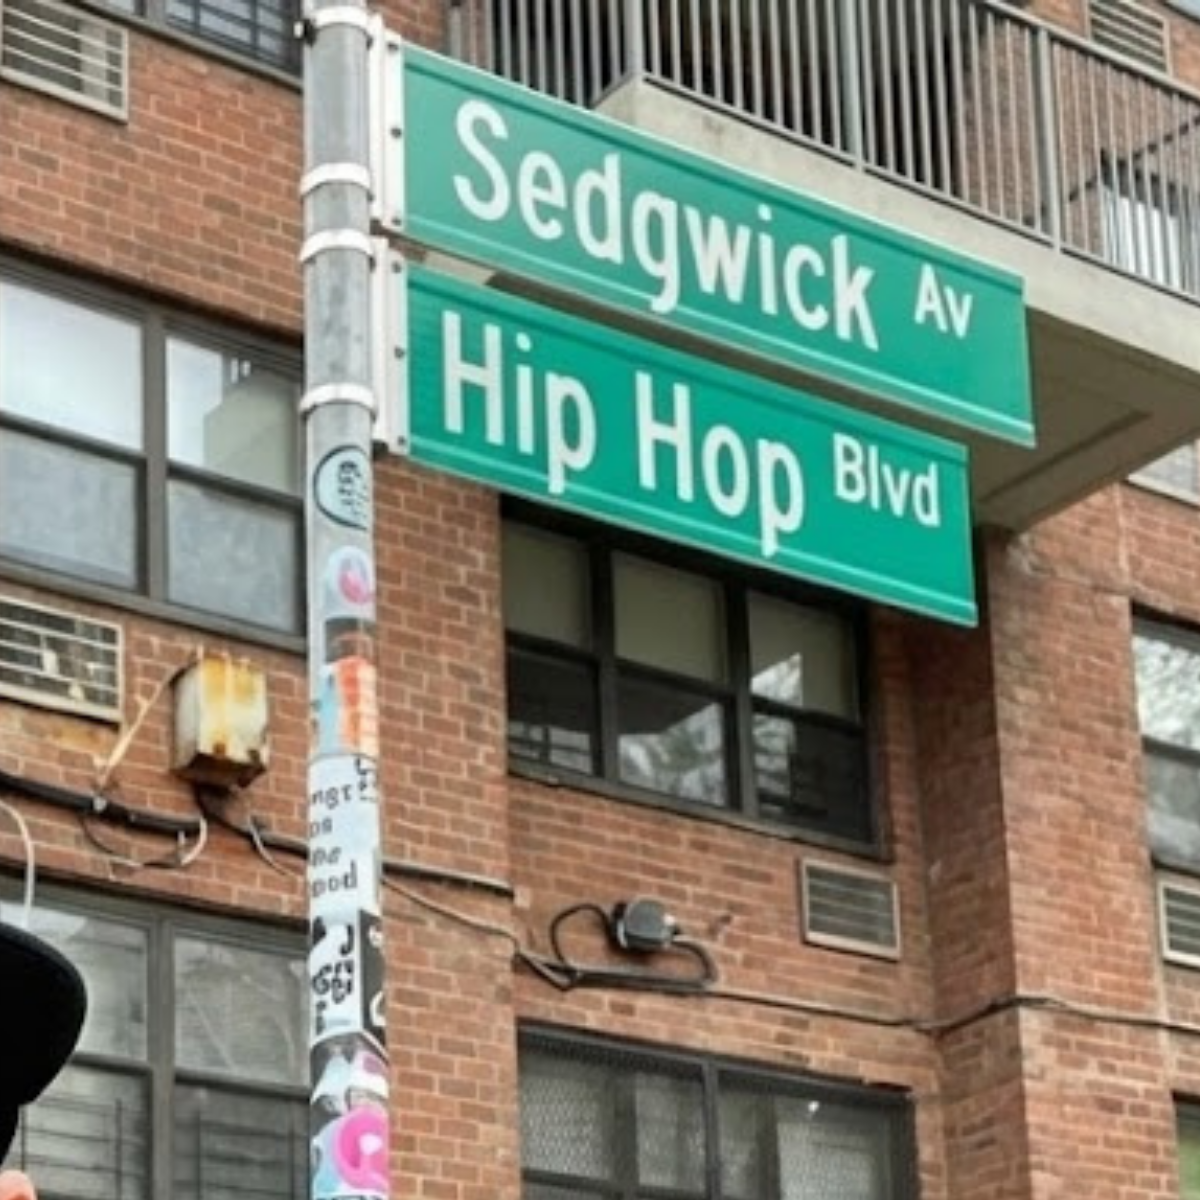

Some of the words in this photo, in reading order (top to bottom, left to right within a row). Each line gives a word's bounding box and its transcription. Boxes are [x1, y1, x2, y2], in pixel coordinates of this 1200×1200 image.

[453, 100, 879, 350] Sedgwick
[914, 263, 973, 339] Av
[442, 310, 597, 493] Hip
[636, 371, 805, 557] Hop
[834, 434, 942, 528] Blvd
